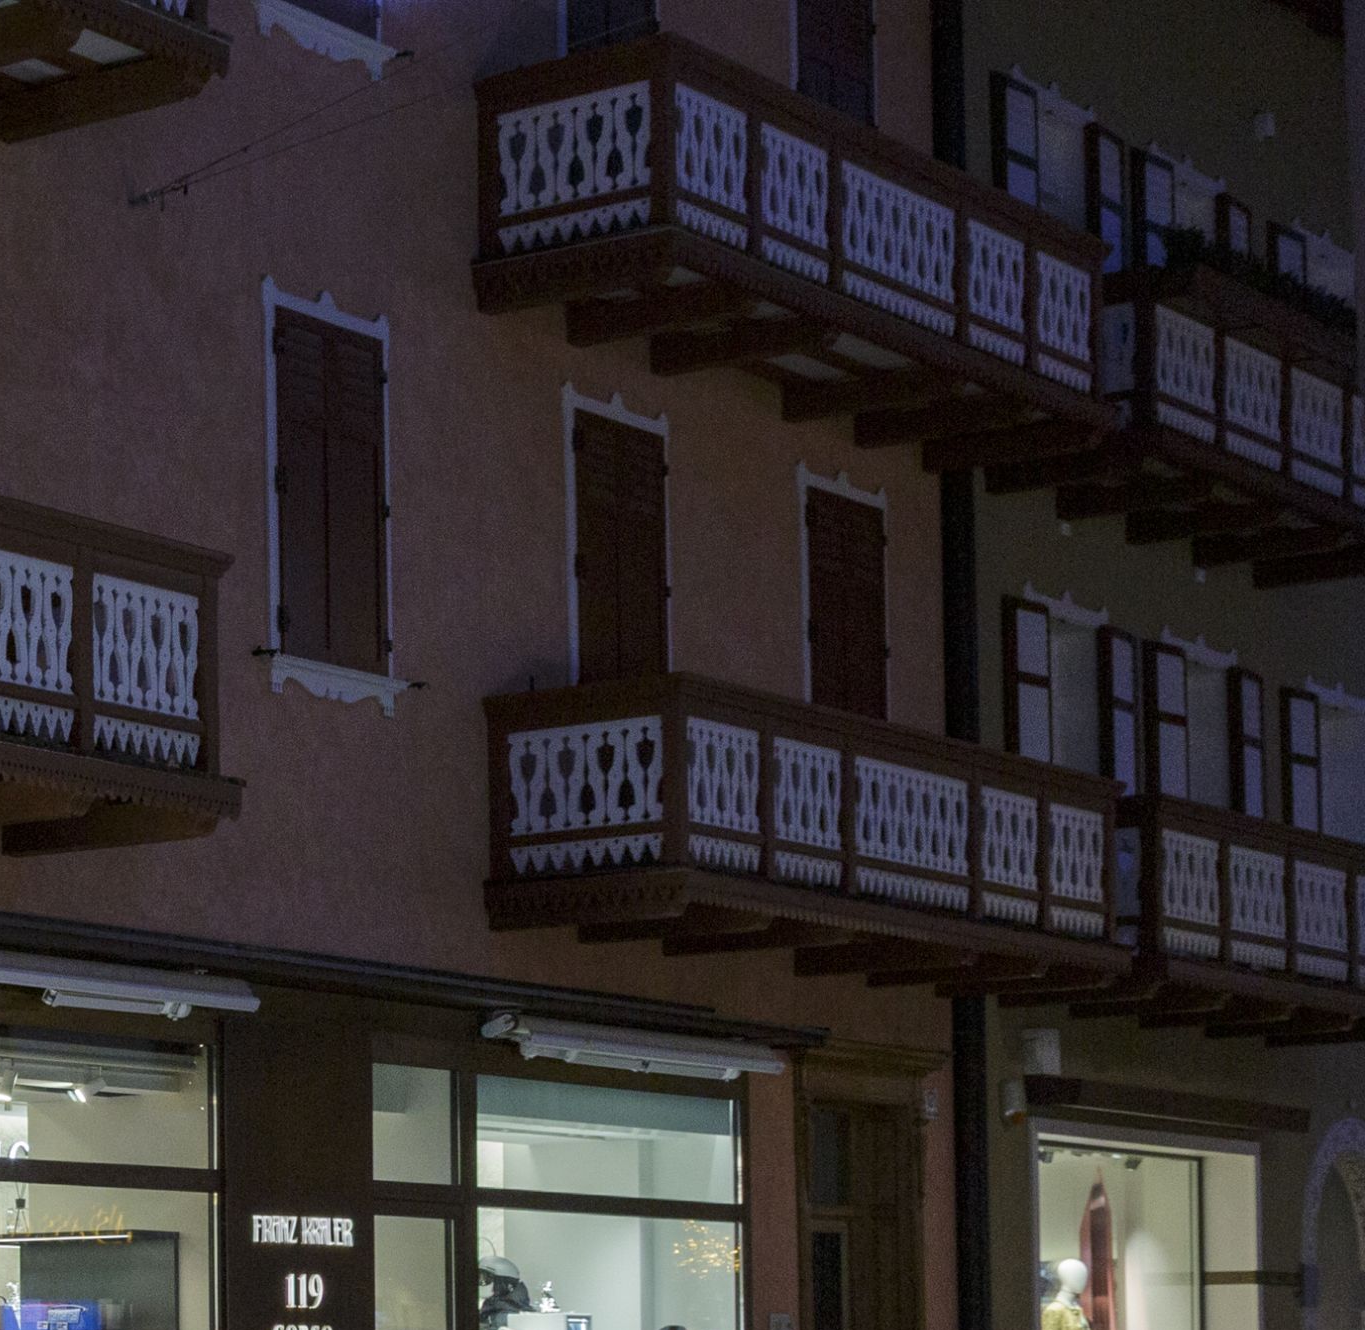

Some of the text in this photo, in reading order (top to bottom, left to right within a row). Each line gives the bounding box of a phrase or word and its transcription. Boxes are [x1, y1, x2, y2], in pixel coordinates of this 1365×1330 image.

[252, 1214, 354, 1247] FRANZ KRALER
[285, 1273, 324, 1310] 119
